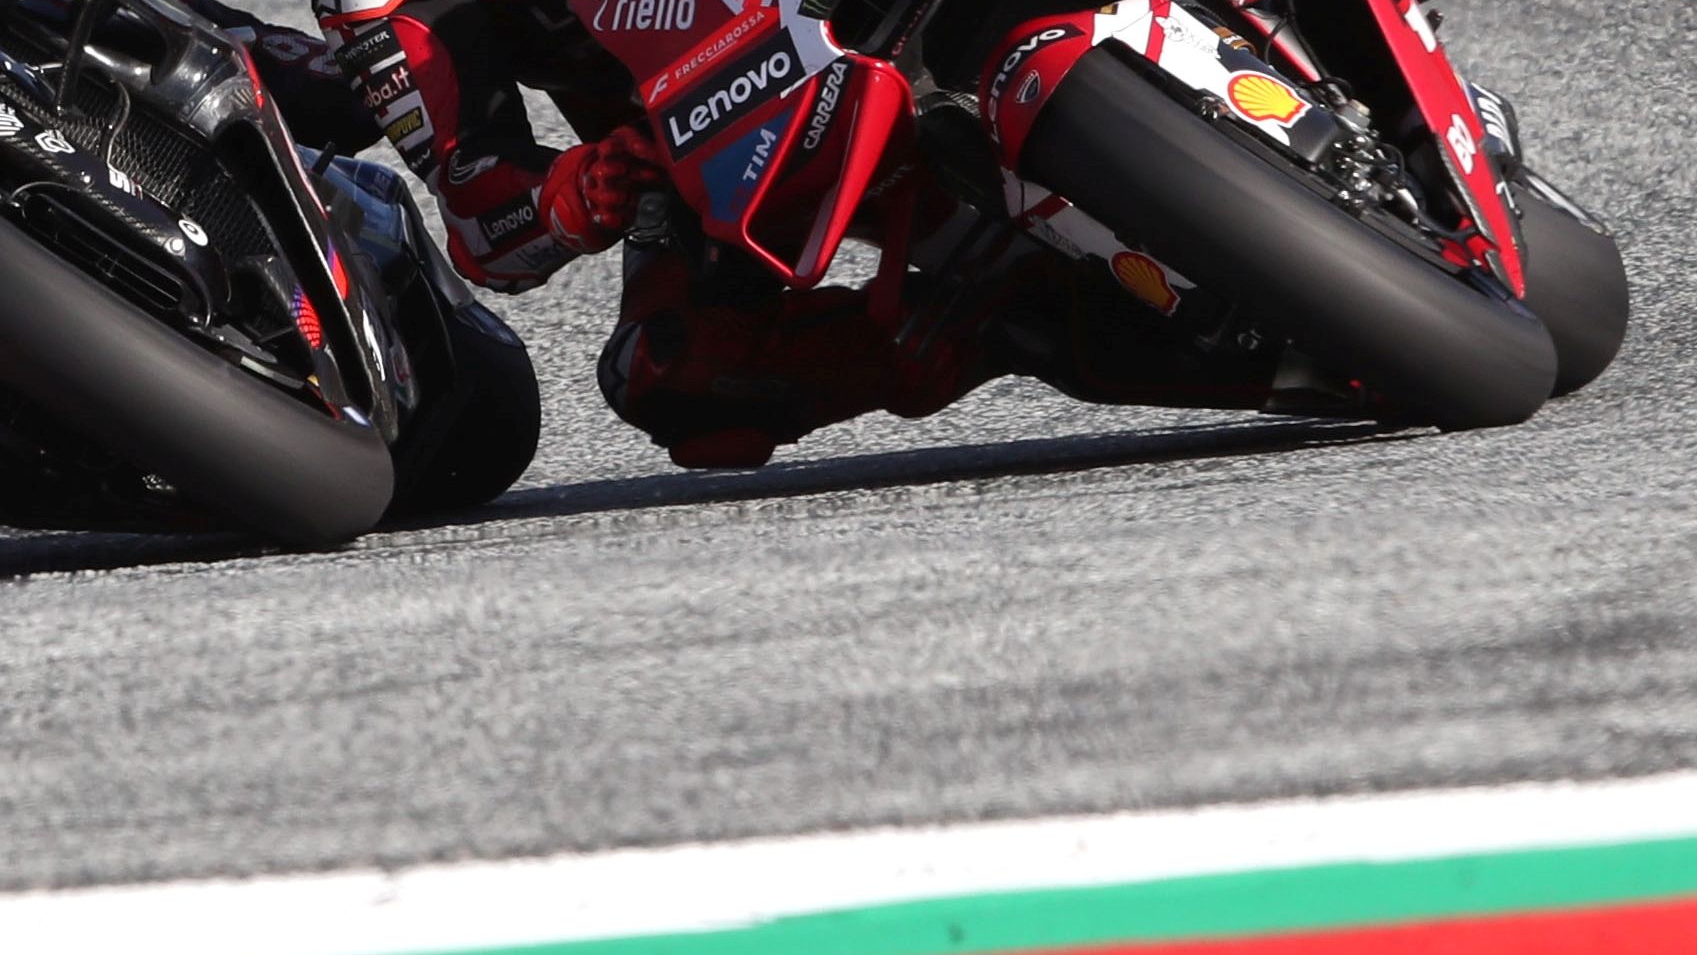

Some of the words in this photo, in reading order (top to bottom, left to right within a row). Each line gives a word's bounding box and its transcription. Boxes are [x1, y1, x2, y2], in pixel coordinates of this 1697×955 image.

[674, 9, 766, 80] FRECCIAROSSA
[668, 50, 791, 147] Lenovo
[803, 61, 849, 150] CARRERA
[742, 127, 777, 181] TIM
[482, 205, 535, 240] Lenovo
